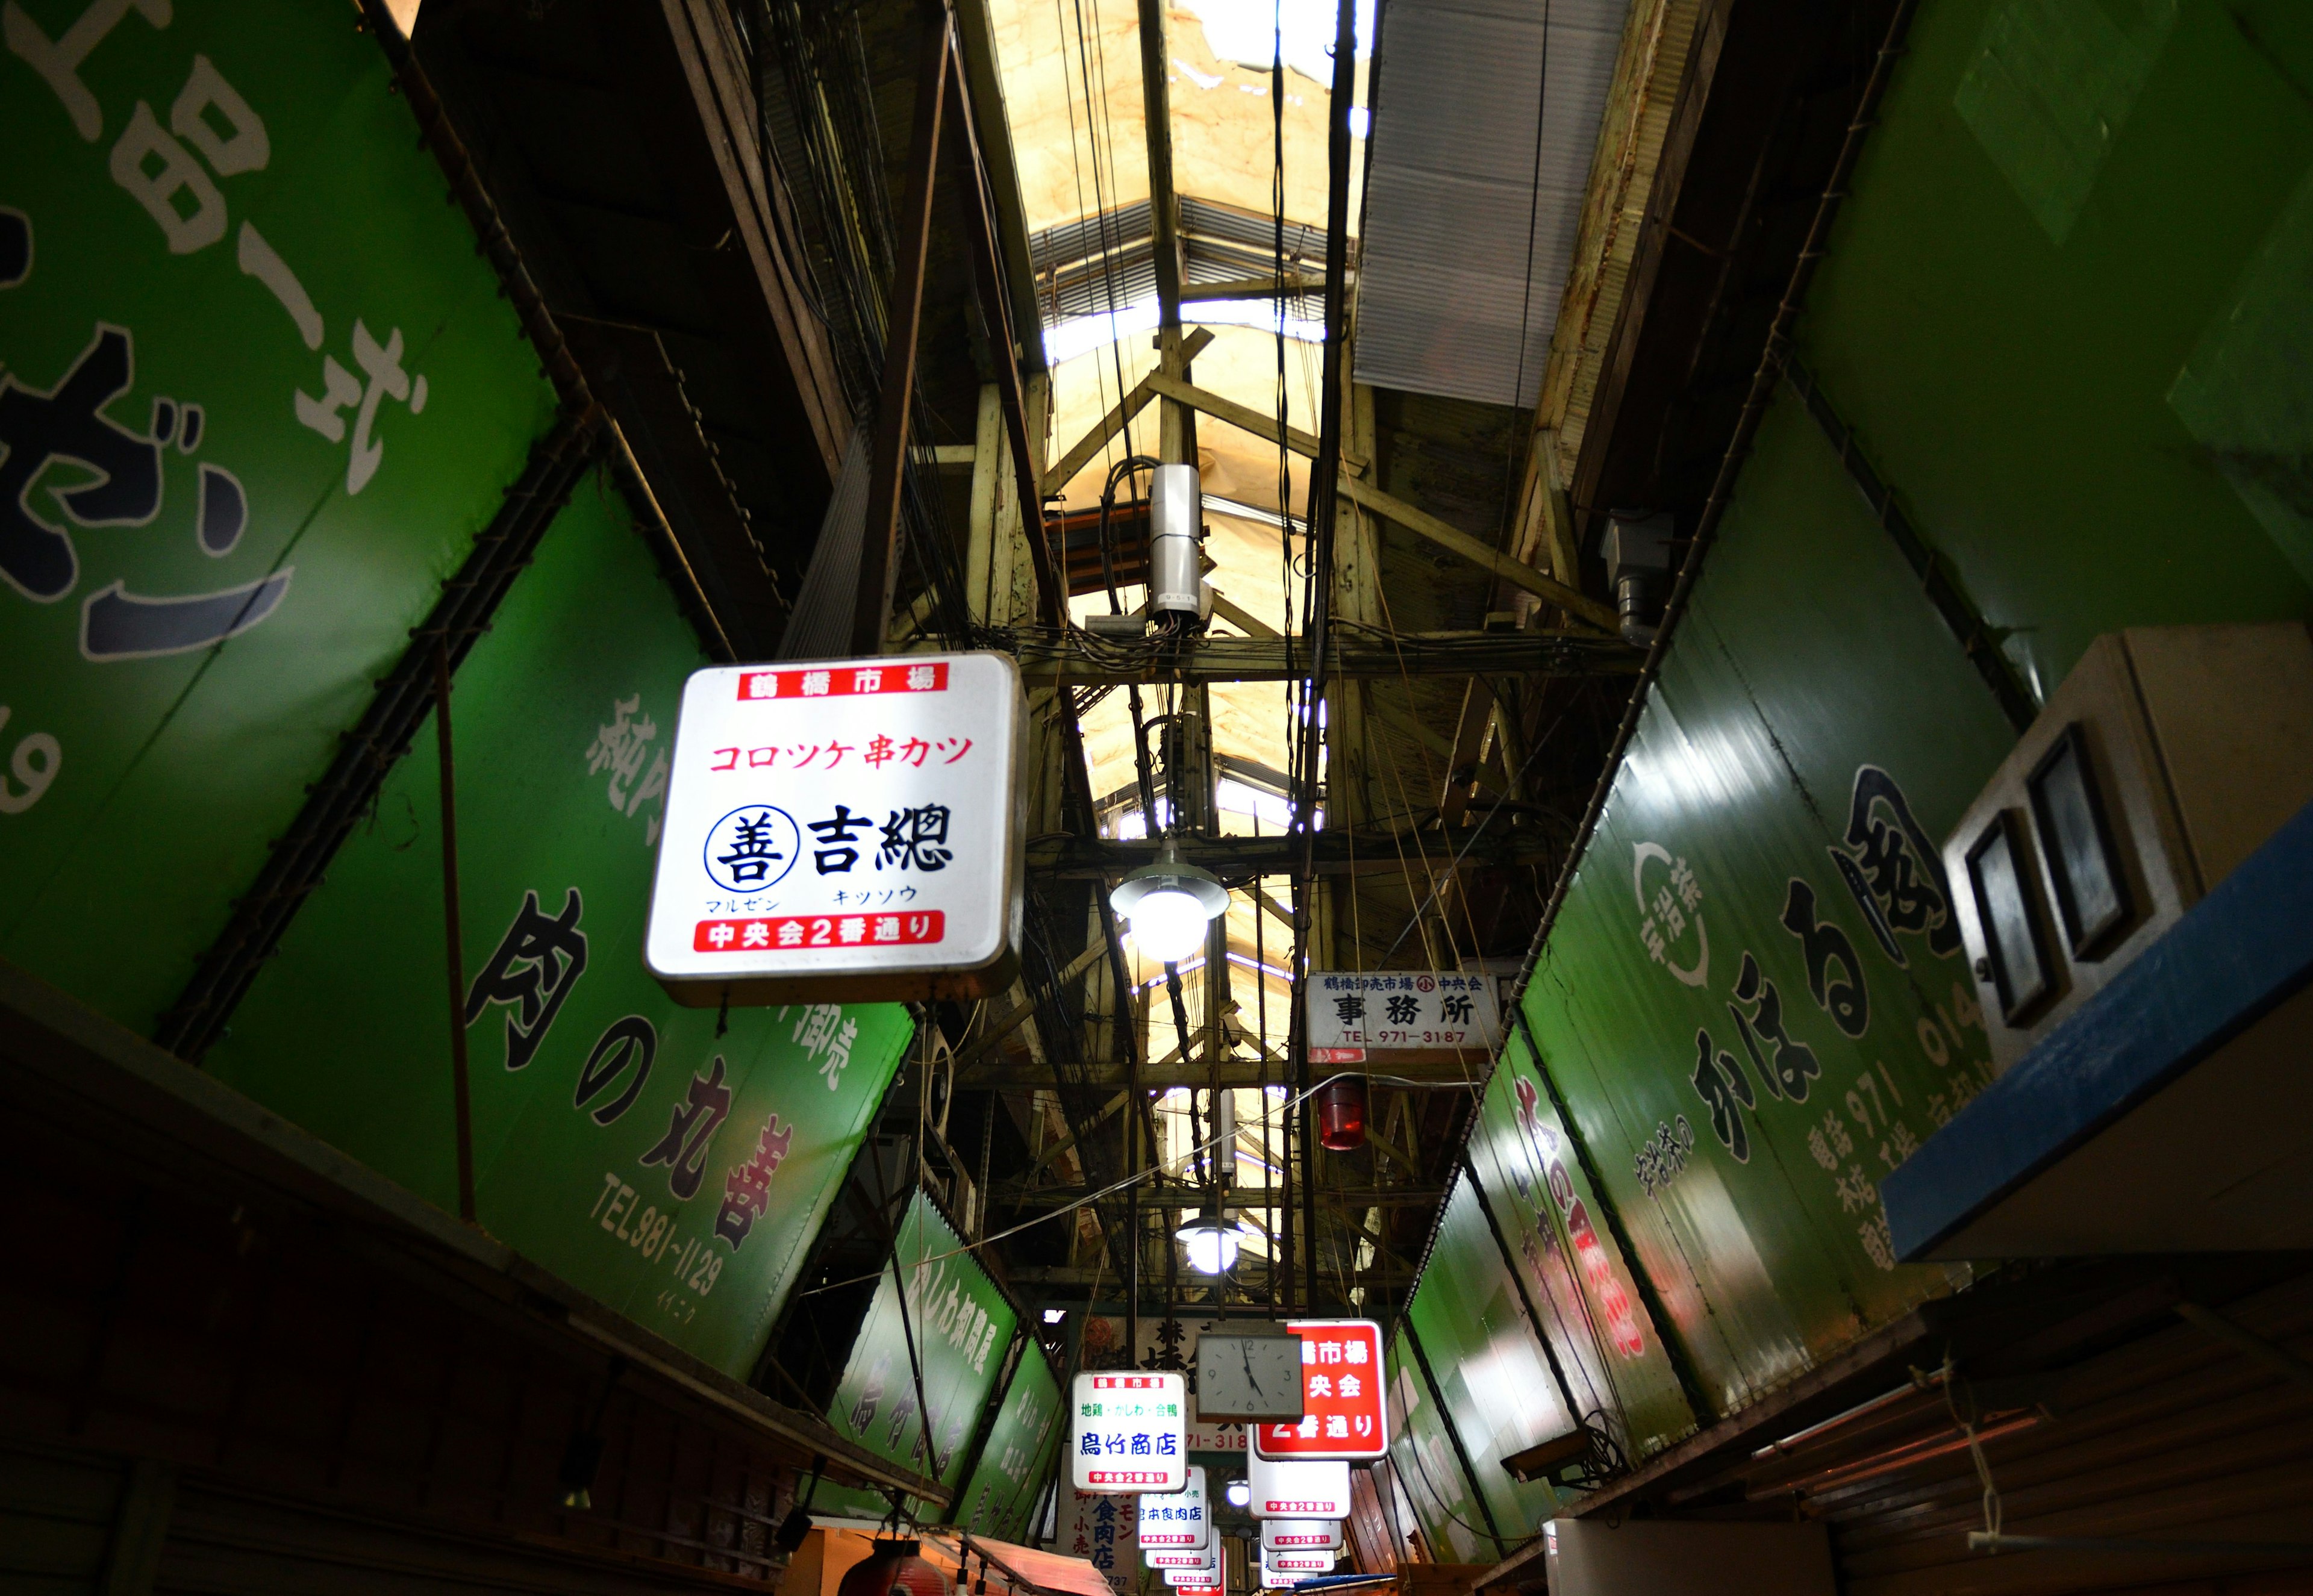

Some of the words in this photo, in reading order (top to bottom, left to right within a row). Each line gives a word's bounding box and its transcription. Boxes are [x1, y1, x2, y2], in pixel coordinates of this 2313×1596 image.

[0, 205, 295, 662] ゼン
[749, 666, 935, 699] 鶴橋市場
[707, 898, 780, 913] マルゼン
[709, 917, 931, 949] 中央会2番通り
[1324, 977, 1414, 991] 鶴橋卸売市場
[1438, 977, 1482, 991] 中央会
[1333, 994, 1475, 1025] 事務所
[1343, 1031, 1373, 1043] TEL
[1379, 1030, 1466, 1044] 971-3187
[464, 887, 793, 1252] 肉の丸善
[1808, 1109, 1853, 1171] 電話
[1846, 1060, 1903, 1139] 971
[1836, 1164, 1877, 1214] 本店
[1244, 1340, 1254, 1351] 12
[1097, 1377, 1160, 1388] 鶴橋市場
[1208, 1369, 1216, 1380] 9
[1284, 1370, 1291, 1382] 3
[1309, 1373, 1361, 1398] 央会
[1081, 1403, 1178, 1417] 地鶏・かしわ・合鴨
[1246, 1400, 1255, 1411] 6
[1080, 1432, 1177, 1456] 鳥竹商店
[1093, 1473, 1164, 1483] 中央会2番通り
[1270, 1502, 1332, 1511] 中央会2番通り
[1092, 1495, 1118, 1569] 食肉店
[1278, 1536, 1328, 1544] 中央会2番通り
